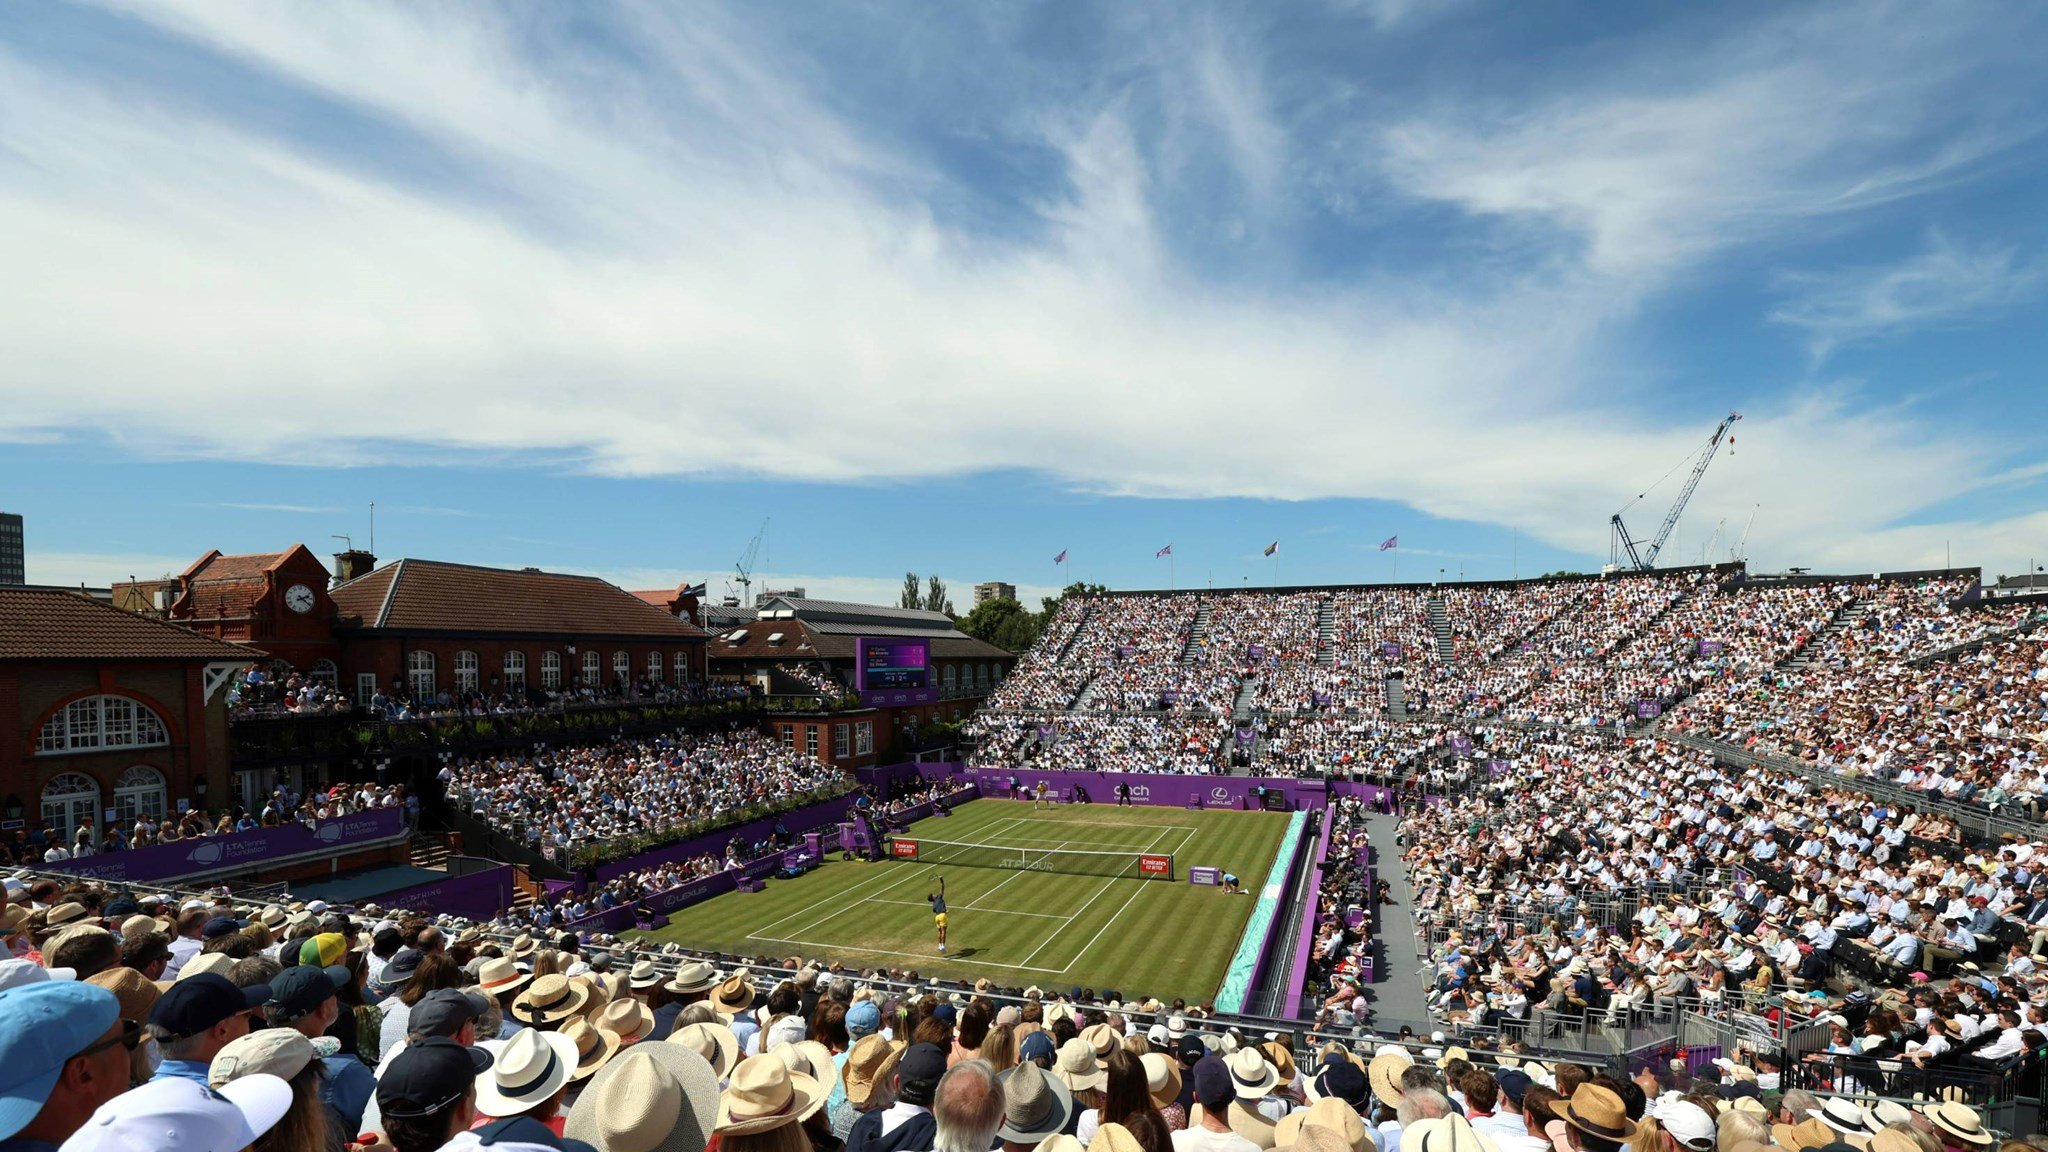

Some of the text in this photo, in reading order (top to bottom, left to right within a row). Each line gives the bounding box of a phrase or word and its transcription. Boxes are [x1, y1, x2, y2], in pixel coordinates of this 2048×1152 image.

[1114, 785, 1150, 796] cnch
[226, 842, 245, 851] LTA
[226, 846, 267, 857] Foundation
[896, 842, 916, 850] Emirates
[998, 859, 1055, 872] ATP TOUR
[1143, 859, 1167, 867] Emirates
[676, 885, 708, 902] LEXUS
